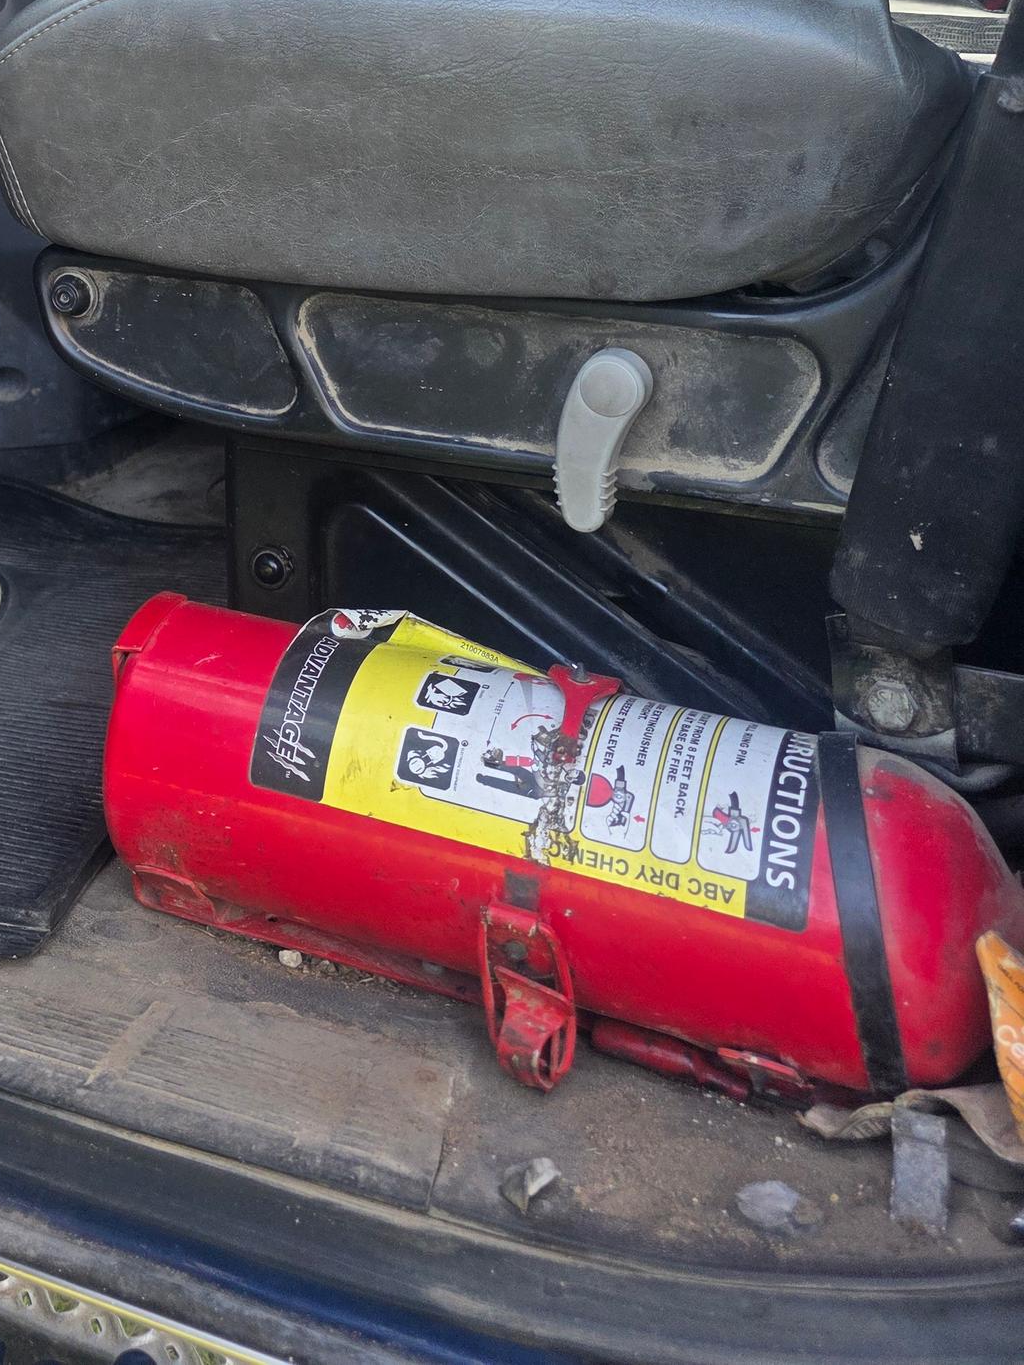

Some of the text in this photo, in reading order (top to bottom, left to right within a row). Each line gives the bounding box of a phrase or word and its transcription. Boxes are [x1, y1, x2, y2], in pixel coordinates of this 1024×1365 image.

[275, 635, 339, 762] ADVANTAGE
[612, 718, 626, 732] THE
[676, 723, 691, 742] BASE
[690, 726, 704, 746] FROM
[636, 710, 663, 766] EXTINGUISHER
[673, 744, 684, 756] OF
[740, 732, 752, 748] RING
[602, 734, 620, 768] LEVER.
[734, 749, 748, 766] PIN.
[666, 758, 680, 784] FIRE.
[682, 754, 695, 780] FEET
[674, 782, 689, 818] BACK.
[635, 865, 680, 890] DRY
[687, 877, 736, 904] ABC
